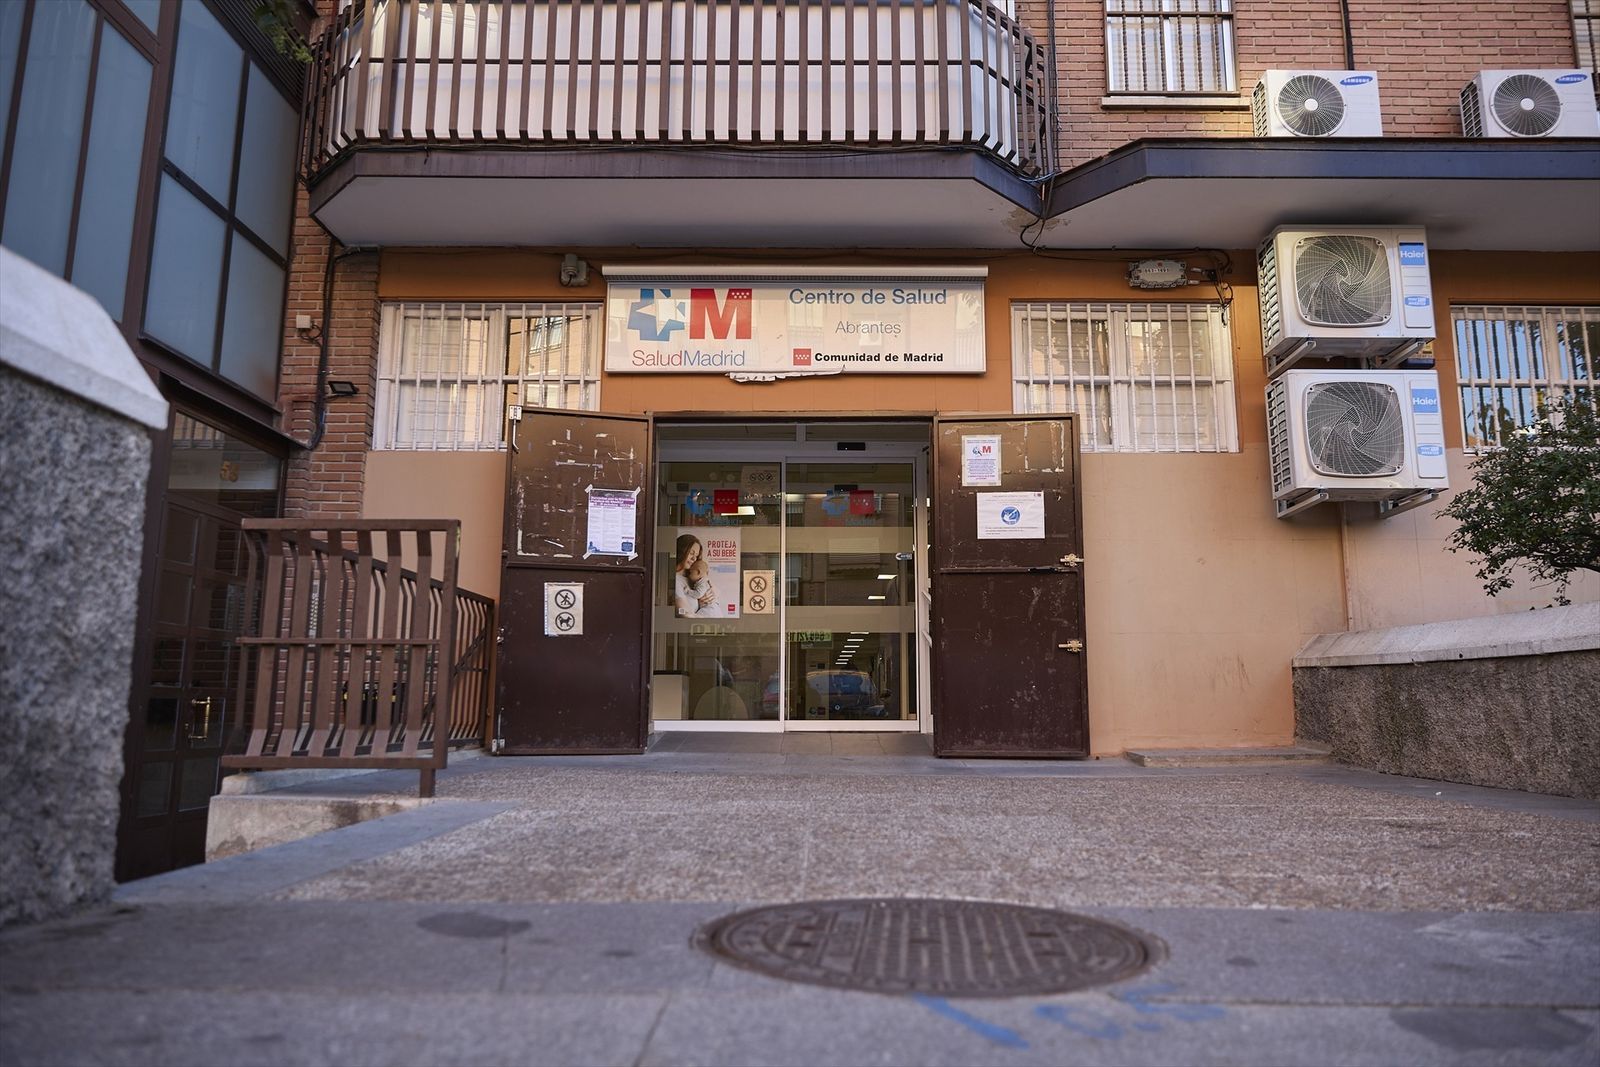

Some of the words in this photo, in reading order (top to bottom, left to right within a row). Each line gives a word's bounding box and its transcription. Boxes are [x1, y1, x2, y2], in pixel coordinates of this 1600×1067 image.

[1399, 250, 1425, 259] Haier
[789, 288, 855, 304] Centro
[861, 288, 886, 304] de
[892, 288, 947, 304] Salud
[835, 320, 902, 335] Abrantes
[631, 349, 746, 367] SaludMadrid
[814, 352, 881, 362] Comunidad
[884, 352, 899, 362] de
[903, 352, 944, 362] Madrid
[1412, 397, 1437, 406] Haier
[707, 540, 737, 548] PROTEJA
[707, 549, 712, 557] A
[712, 549, 721, 557] SU
[721, 548, 736, 557] BEBÉ
